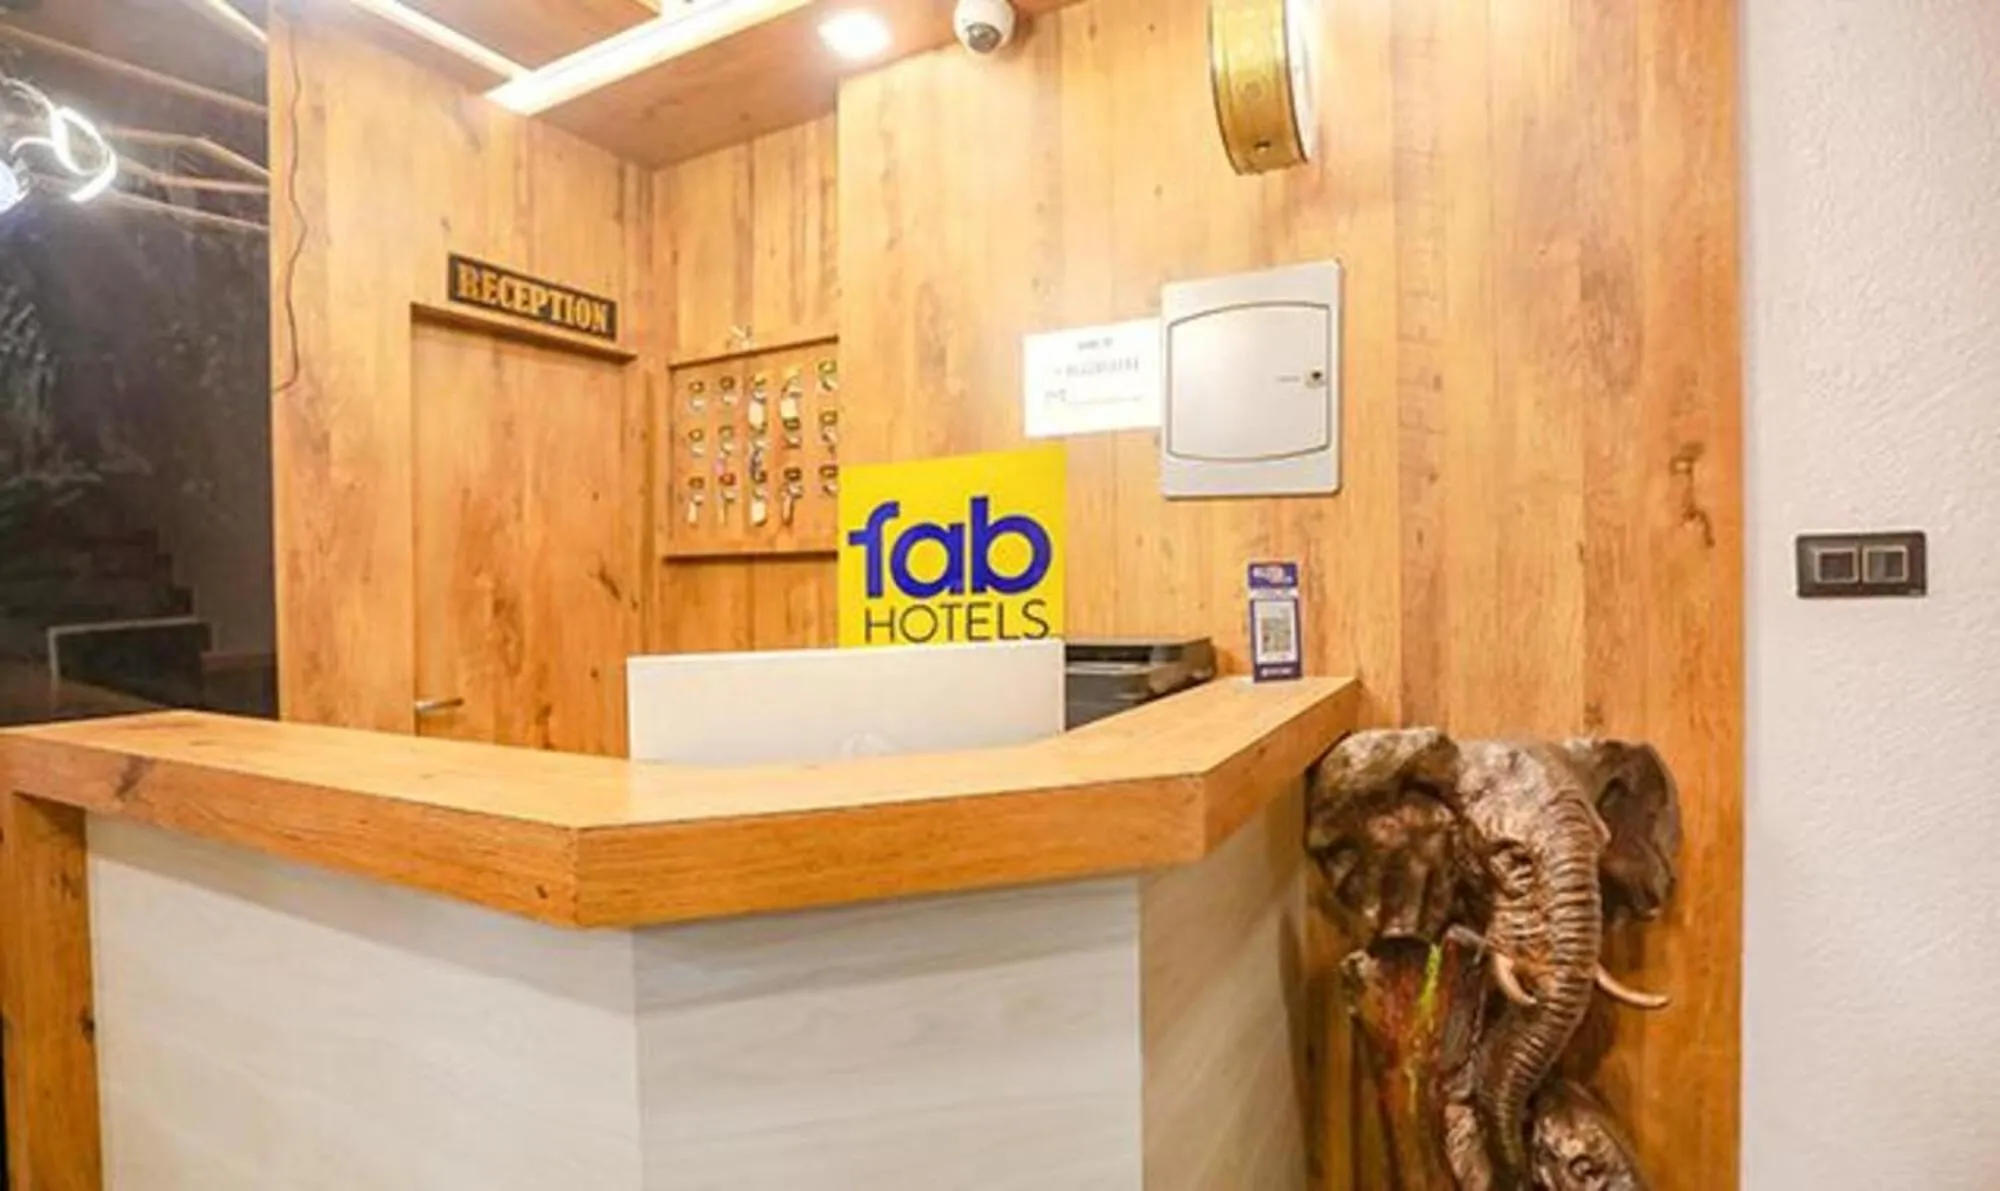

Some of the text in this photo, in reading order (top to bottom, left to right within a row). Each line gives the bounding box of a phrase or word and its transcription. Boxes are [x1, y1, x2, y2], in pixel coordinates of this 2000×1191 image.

[457, 262, 608, 332] RECEPTION
[848, 496, 1052, 599] fab
[865, 599, 1050, 643] HOTELS
